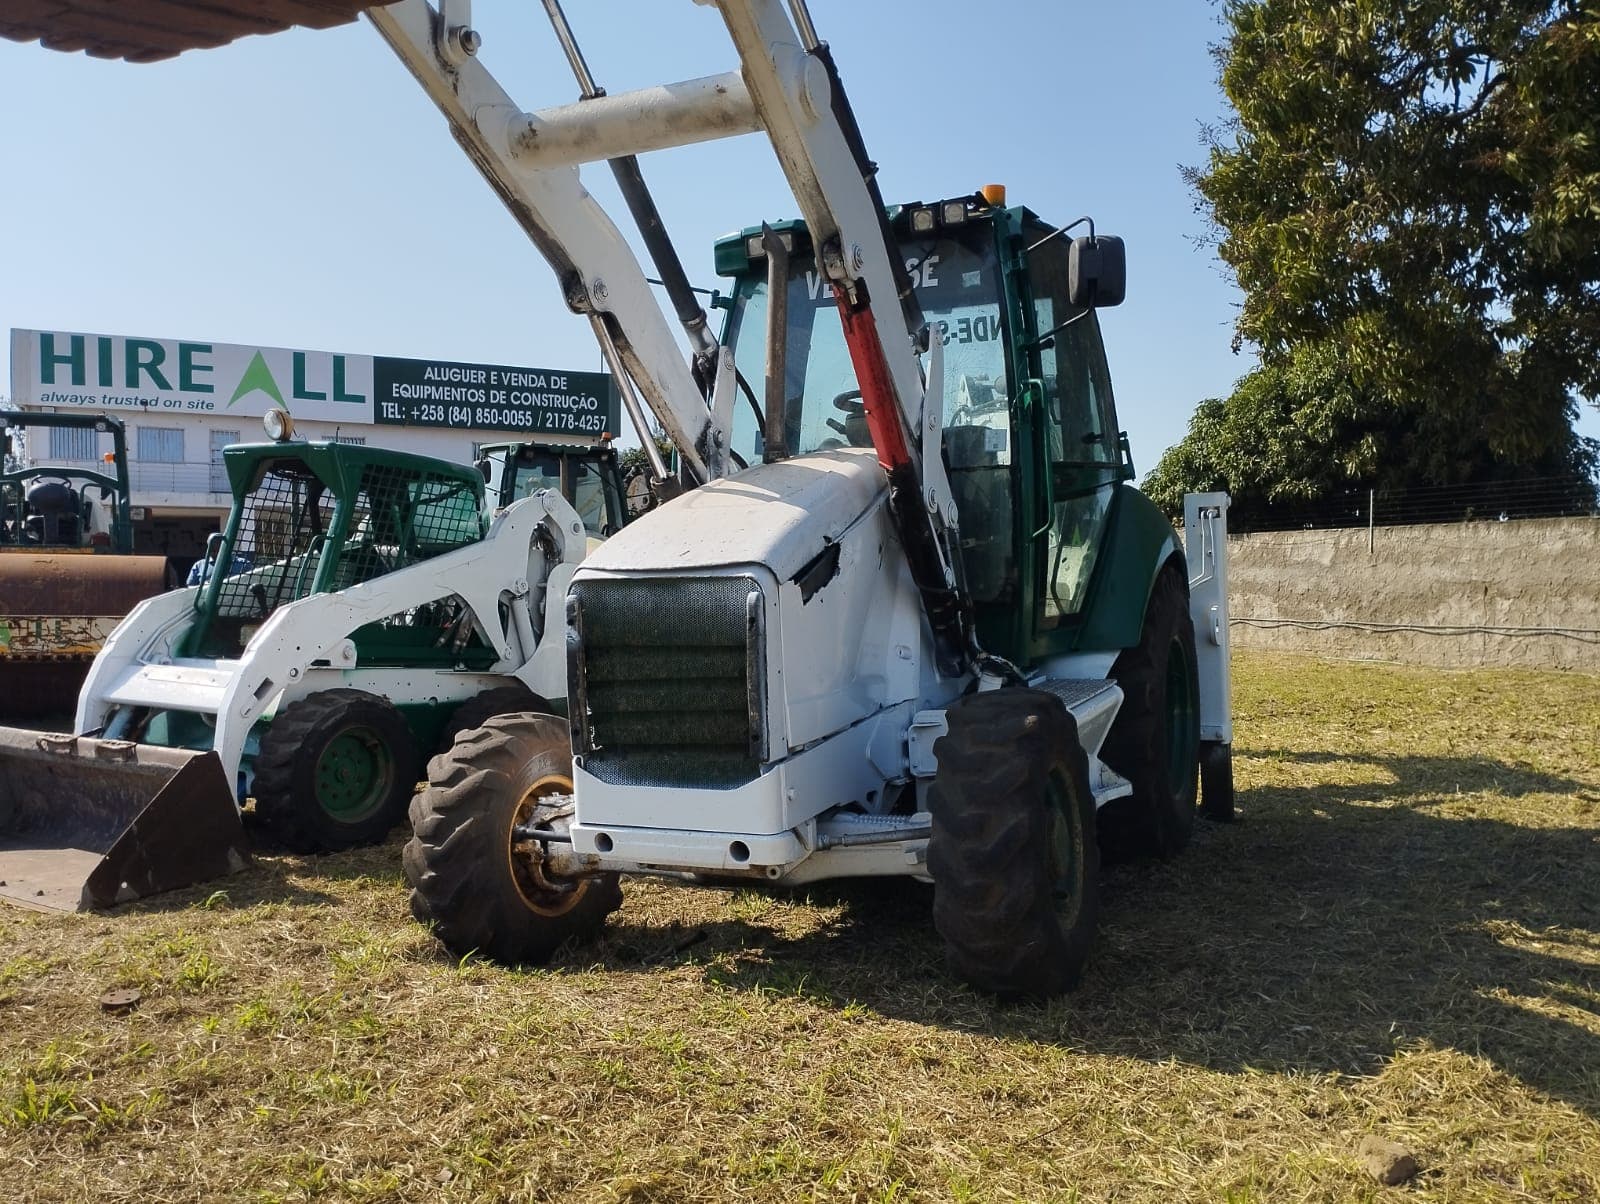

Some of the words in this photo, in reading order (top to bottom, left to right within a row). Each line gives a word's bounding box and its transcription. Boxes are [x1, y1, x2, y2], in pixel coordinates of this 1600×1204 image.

[40, 333, 214, 393] HIRE
[424, 367, 485, 384] ALUGUER
[491, 372, 497, 384] E
[501, 372, 546, 388] VENDA
[551, 377, 567, 390] DE
[41, 392, 96, 404] always
[163, 400, 182, 408] on
[187, 400, 214, 410] site
[393, 384, 485, 402] EQUIPMENTOS
[490, 391, 506, 404] DE
[511, 392, 597, 412] CONSTRUÇÃO
[382, 402, 405, 418] TEL:
[411, 405, 444, 421] +258
[449, 407, 471, 426] (84)
[476, 408, 532, 426] 850-0055
[546, 413, 606, 431] 2178-4257
